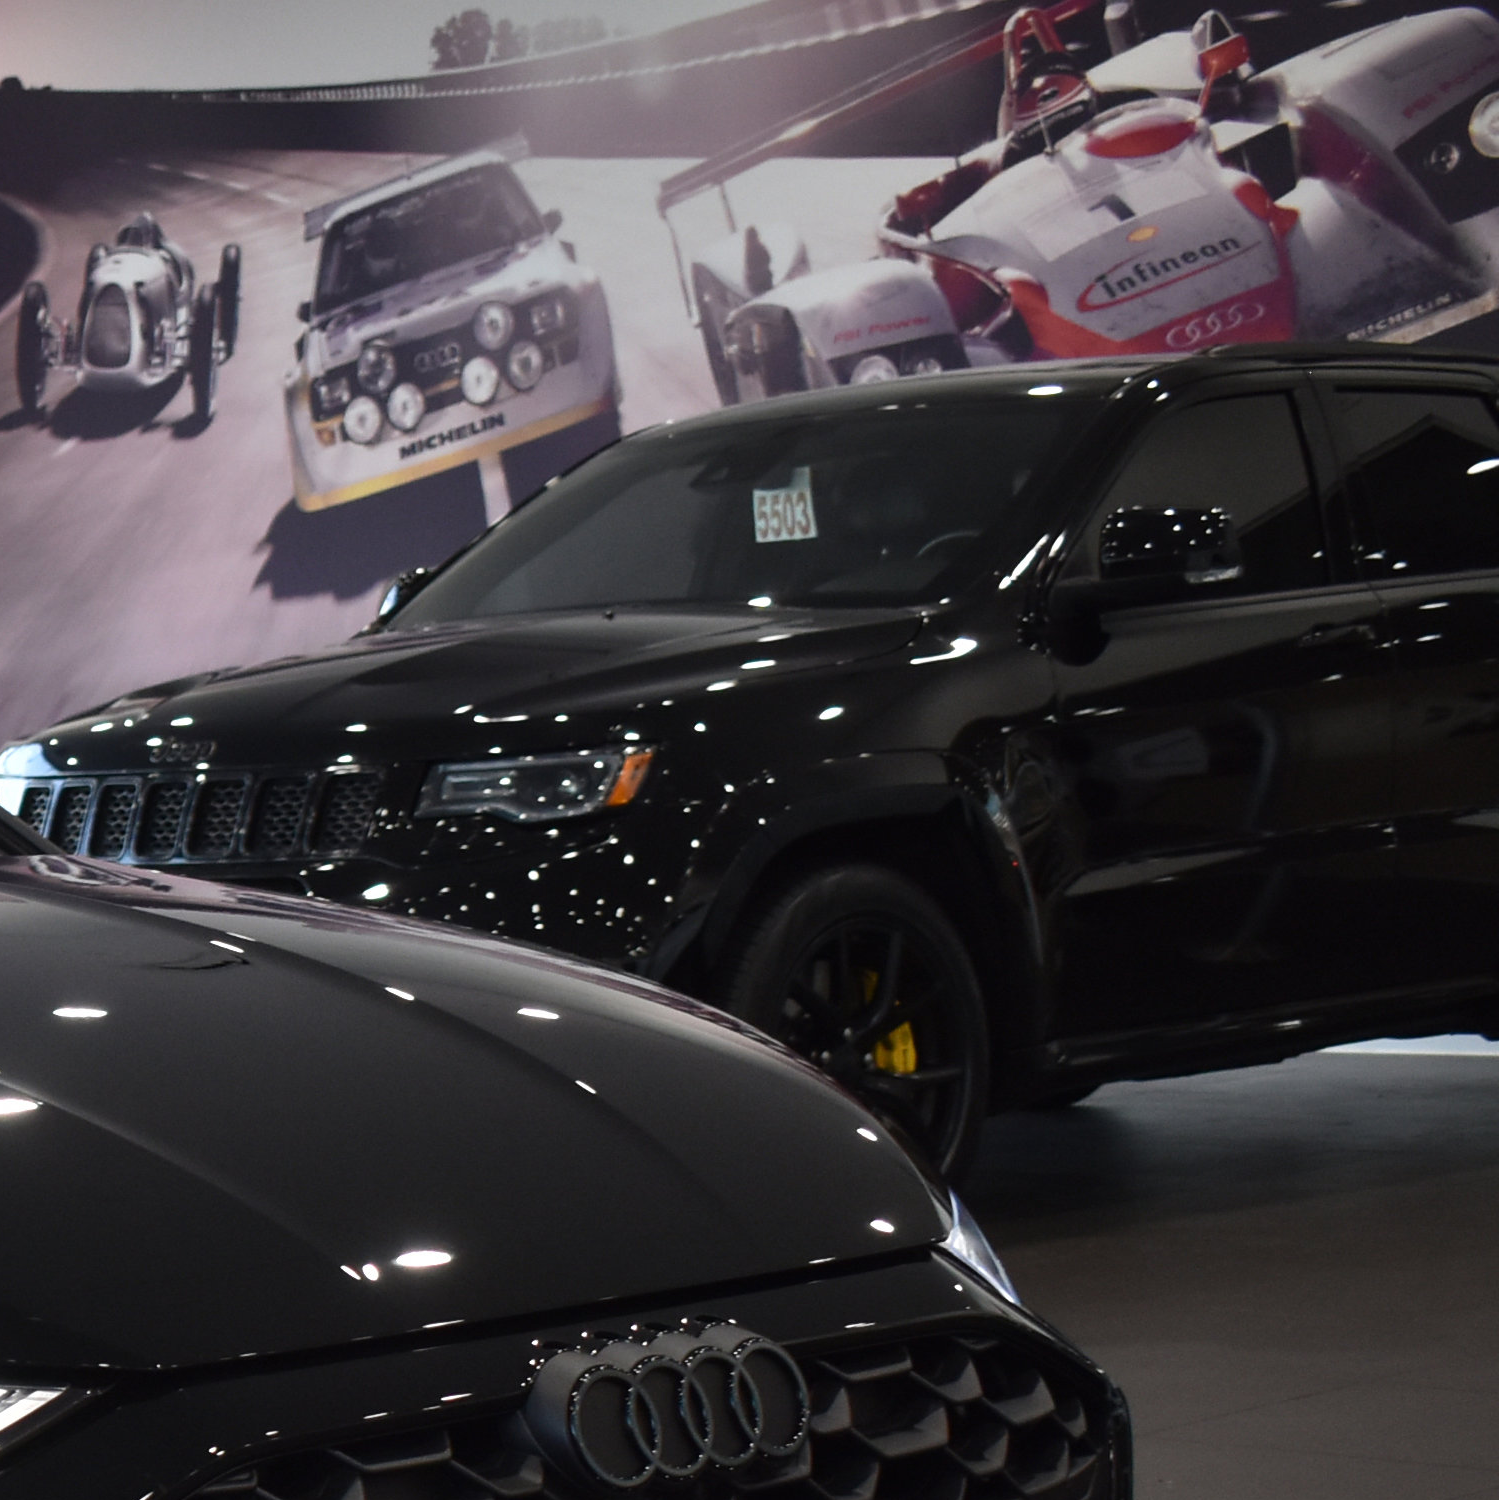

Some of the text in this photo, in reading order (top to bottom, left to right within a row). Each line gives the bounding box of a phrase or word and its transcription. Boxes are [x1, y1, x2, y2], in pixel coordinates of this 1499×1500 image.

[1094, 236, 1241, 299] Infineon
[399, 412, 505, 460] MICHELIN
[757, 491, 811, 539] 5503
